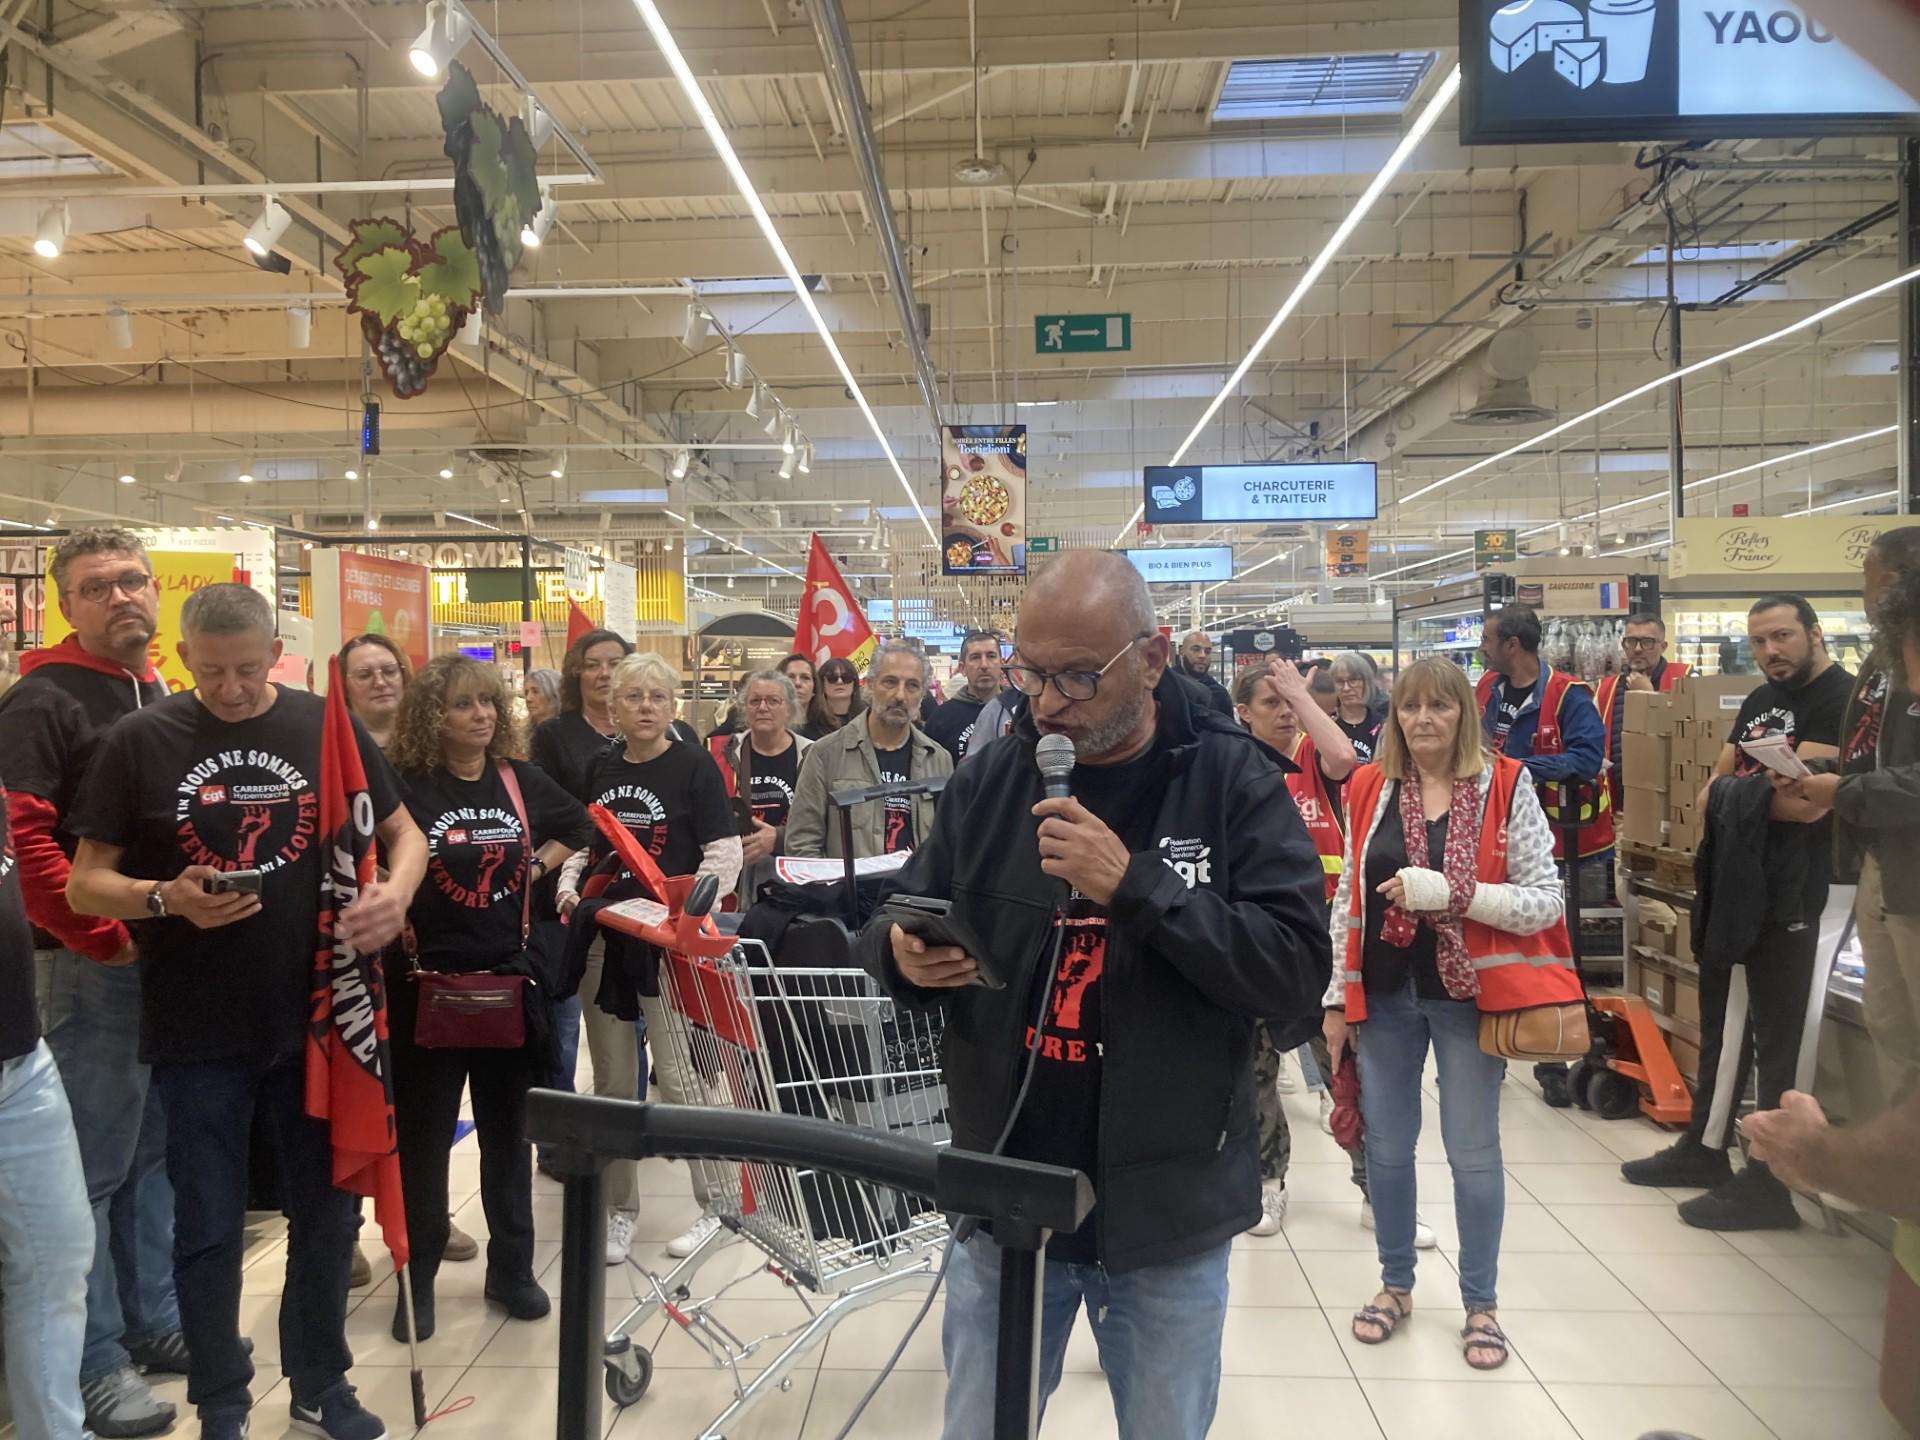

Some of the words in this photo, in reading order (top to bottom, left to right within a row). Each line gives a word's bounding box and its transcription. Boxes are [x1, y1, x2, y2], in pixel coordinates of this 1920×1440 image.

[957, 443, 1010, 455] Tortiglioni
[1243, 480, 1335, 491] CHARCUTERIE
[1251, 495, 1260, 504] &
[1263, 493, 1327, 504] TRAITEUR
[1723, 547, 1774, 562] France
[1191, 560, 1212, 568] PLUS
[1548, 581, 1595, 591] SAUCISSONS
[177, 757, 221, 796] NOUS
[219, 750, 244, 769] NE
[247, 749, 309, 791] SOMMES
[232, 783, 290, 794] CARREFOUR
[202, 787, 226, 804] cgt
[232, 790, 291, 801] Hypermarché
[596, 788, 616, 807] OUS
[618, 785, 634, 798] NE
[633, 786, 667, 821] SOMMES
[458, 807, 477, 820] NE
[617, 811, 652, 820] CARREFOUR
[260, 861, 276, 875] NI
[280, 791, 318, 863] LOUER
[472, 827, 517, 836] CARREFOUR
[648, 823, 669, 856] UER
[1169, 844, 1204, 852] Commerce
[1170, 851, 1196, 859] Services
[429, 858, 490, 908] VENDRE
[492, 891, 503, 902] NI
